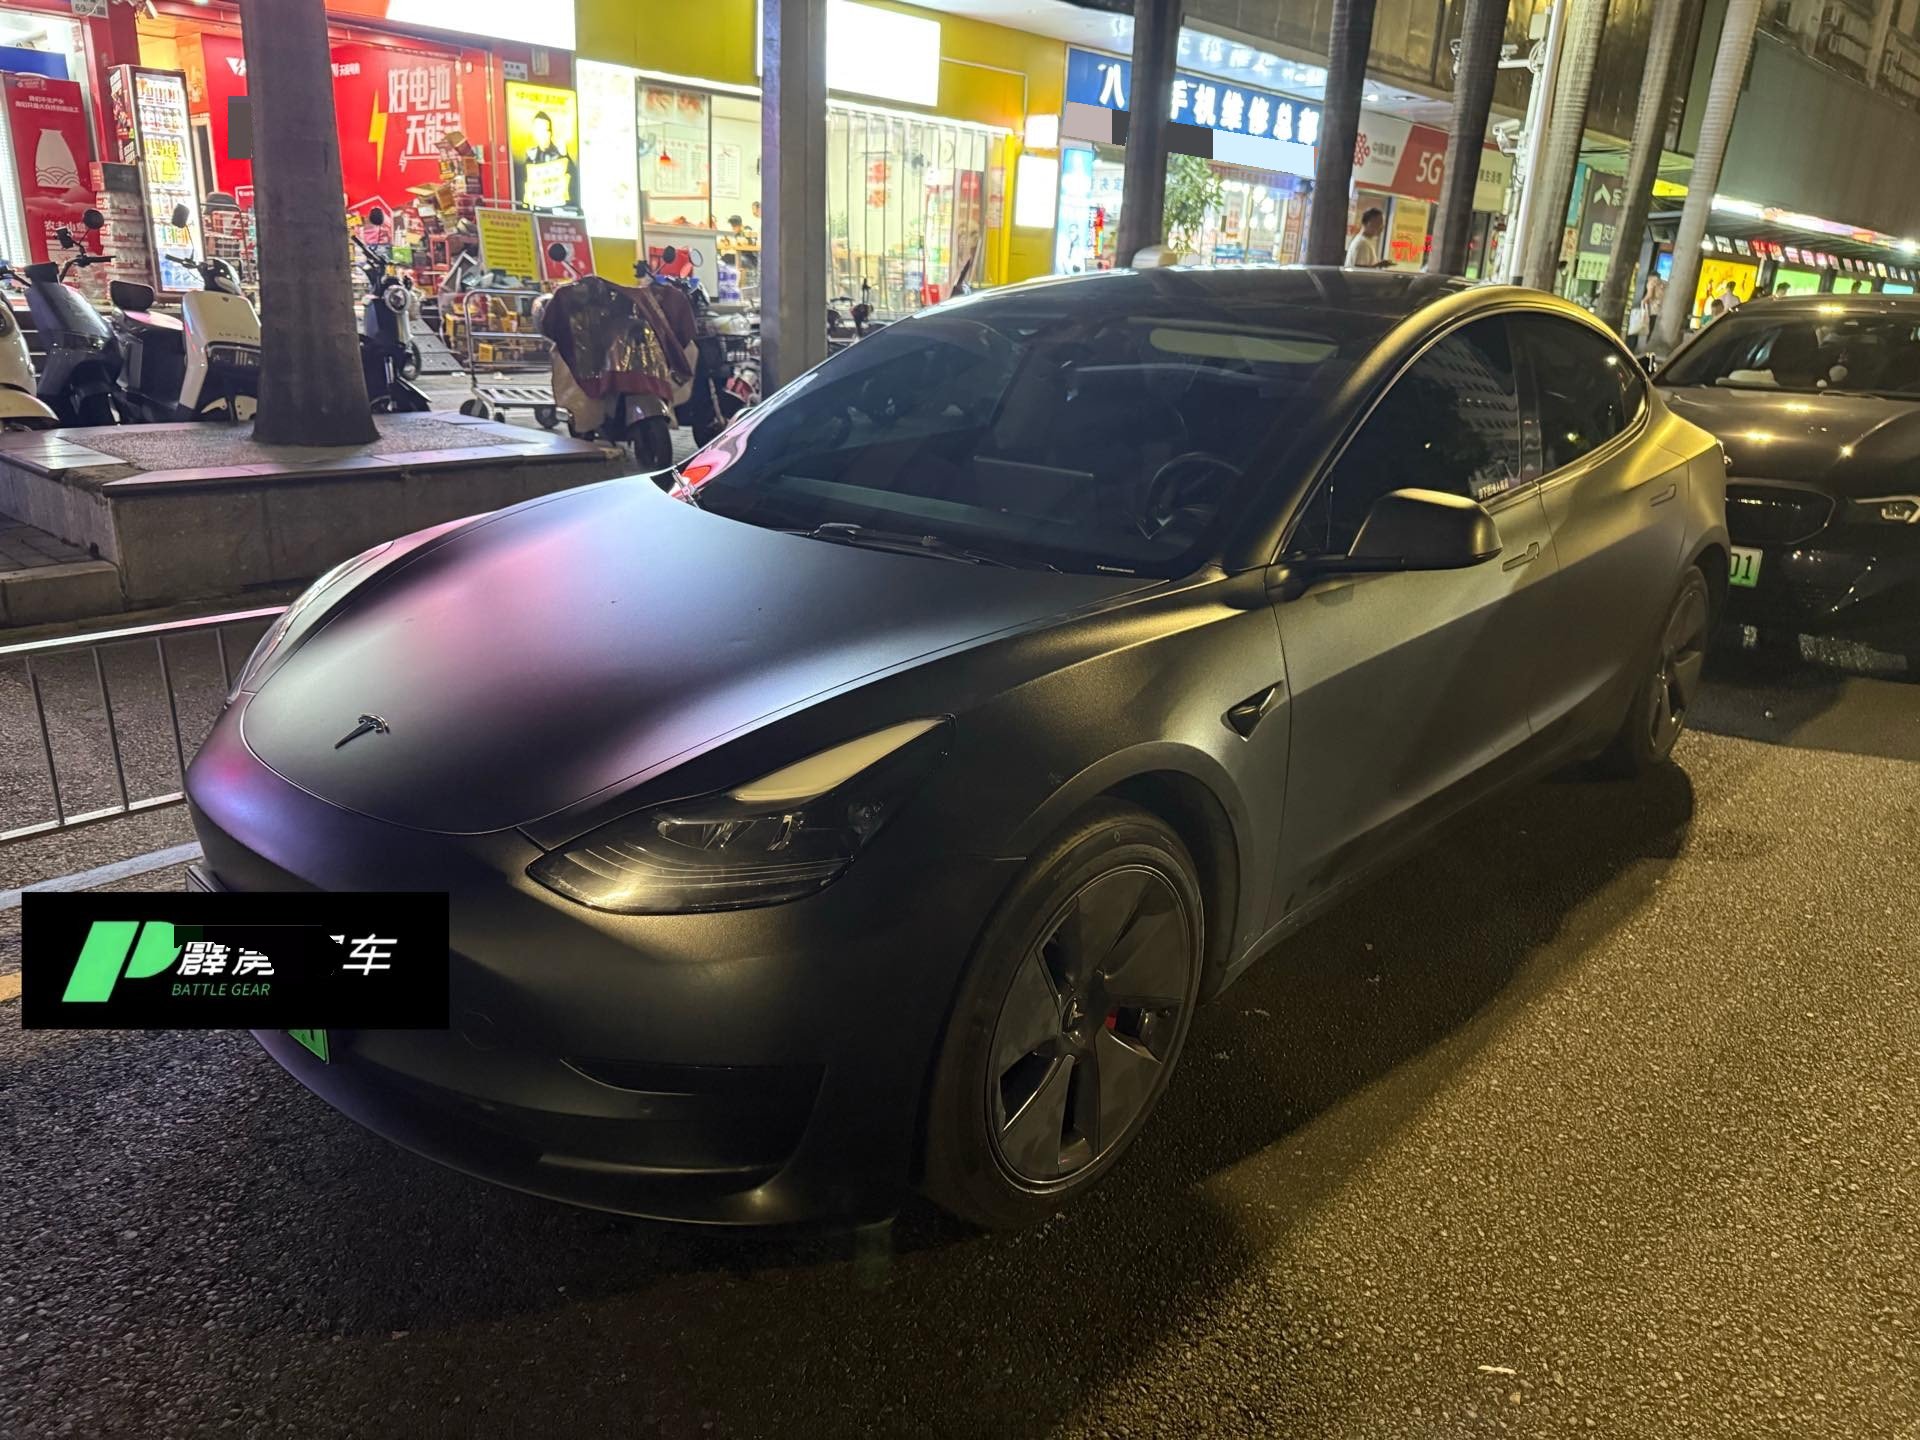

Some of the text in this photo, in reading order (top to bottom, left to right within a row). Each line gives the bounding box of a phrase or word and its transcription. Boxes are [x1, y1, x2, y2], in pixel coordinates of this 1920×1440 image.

[388, 66, 450, 113] 好电池
[1416, 151, 1443, 185] 5G
